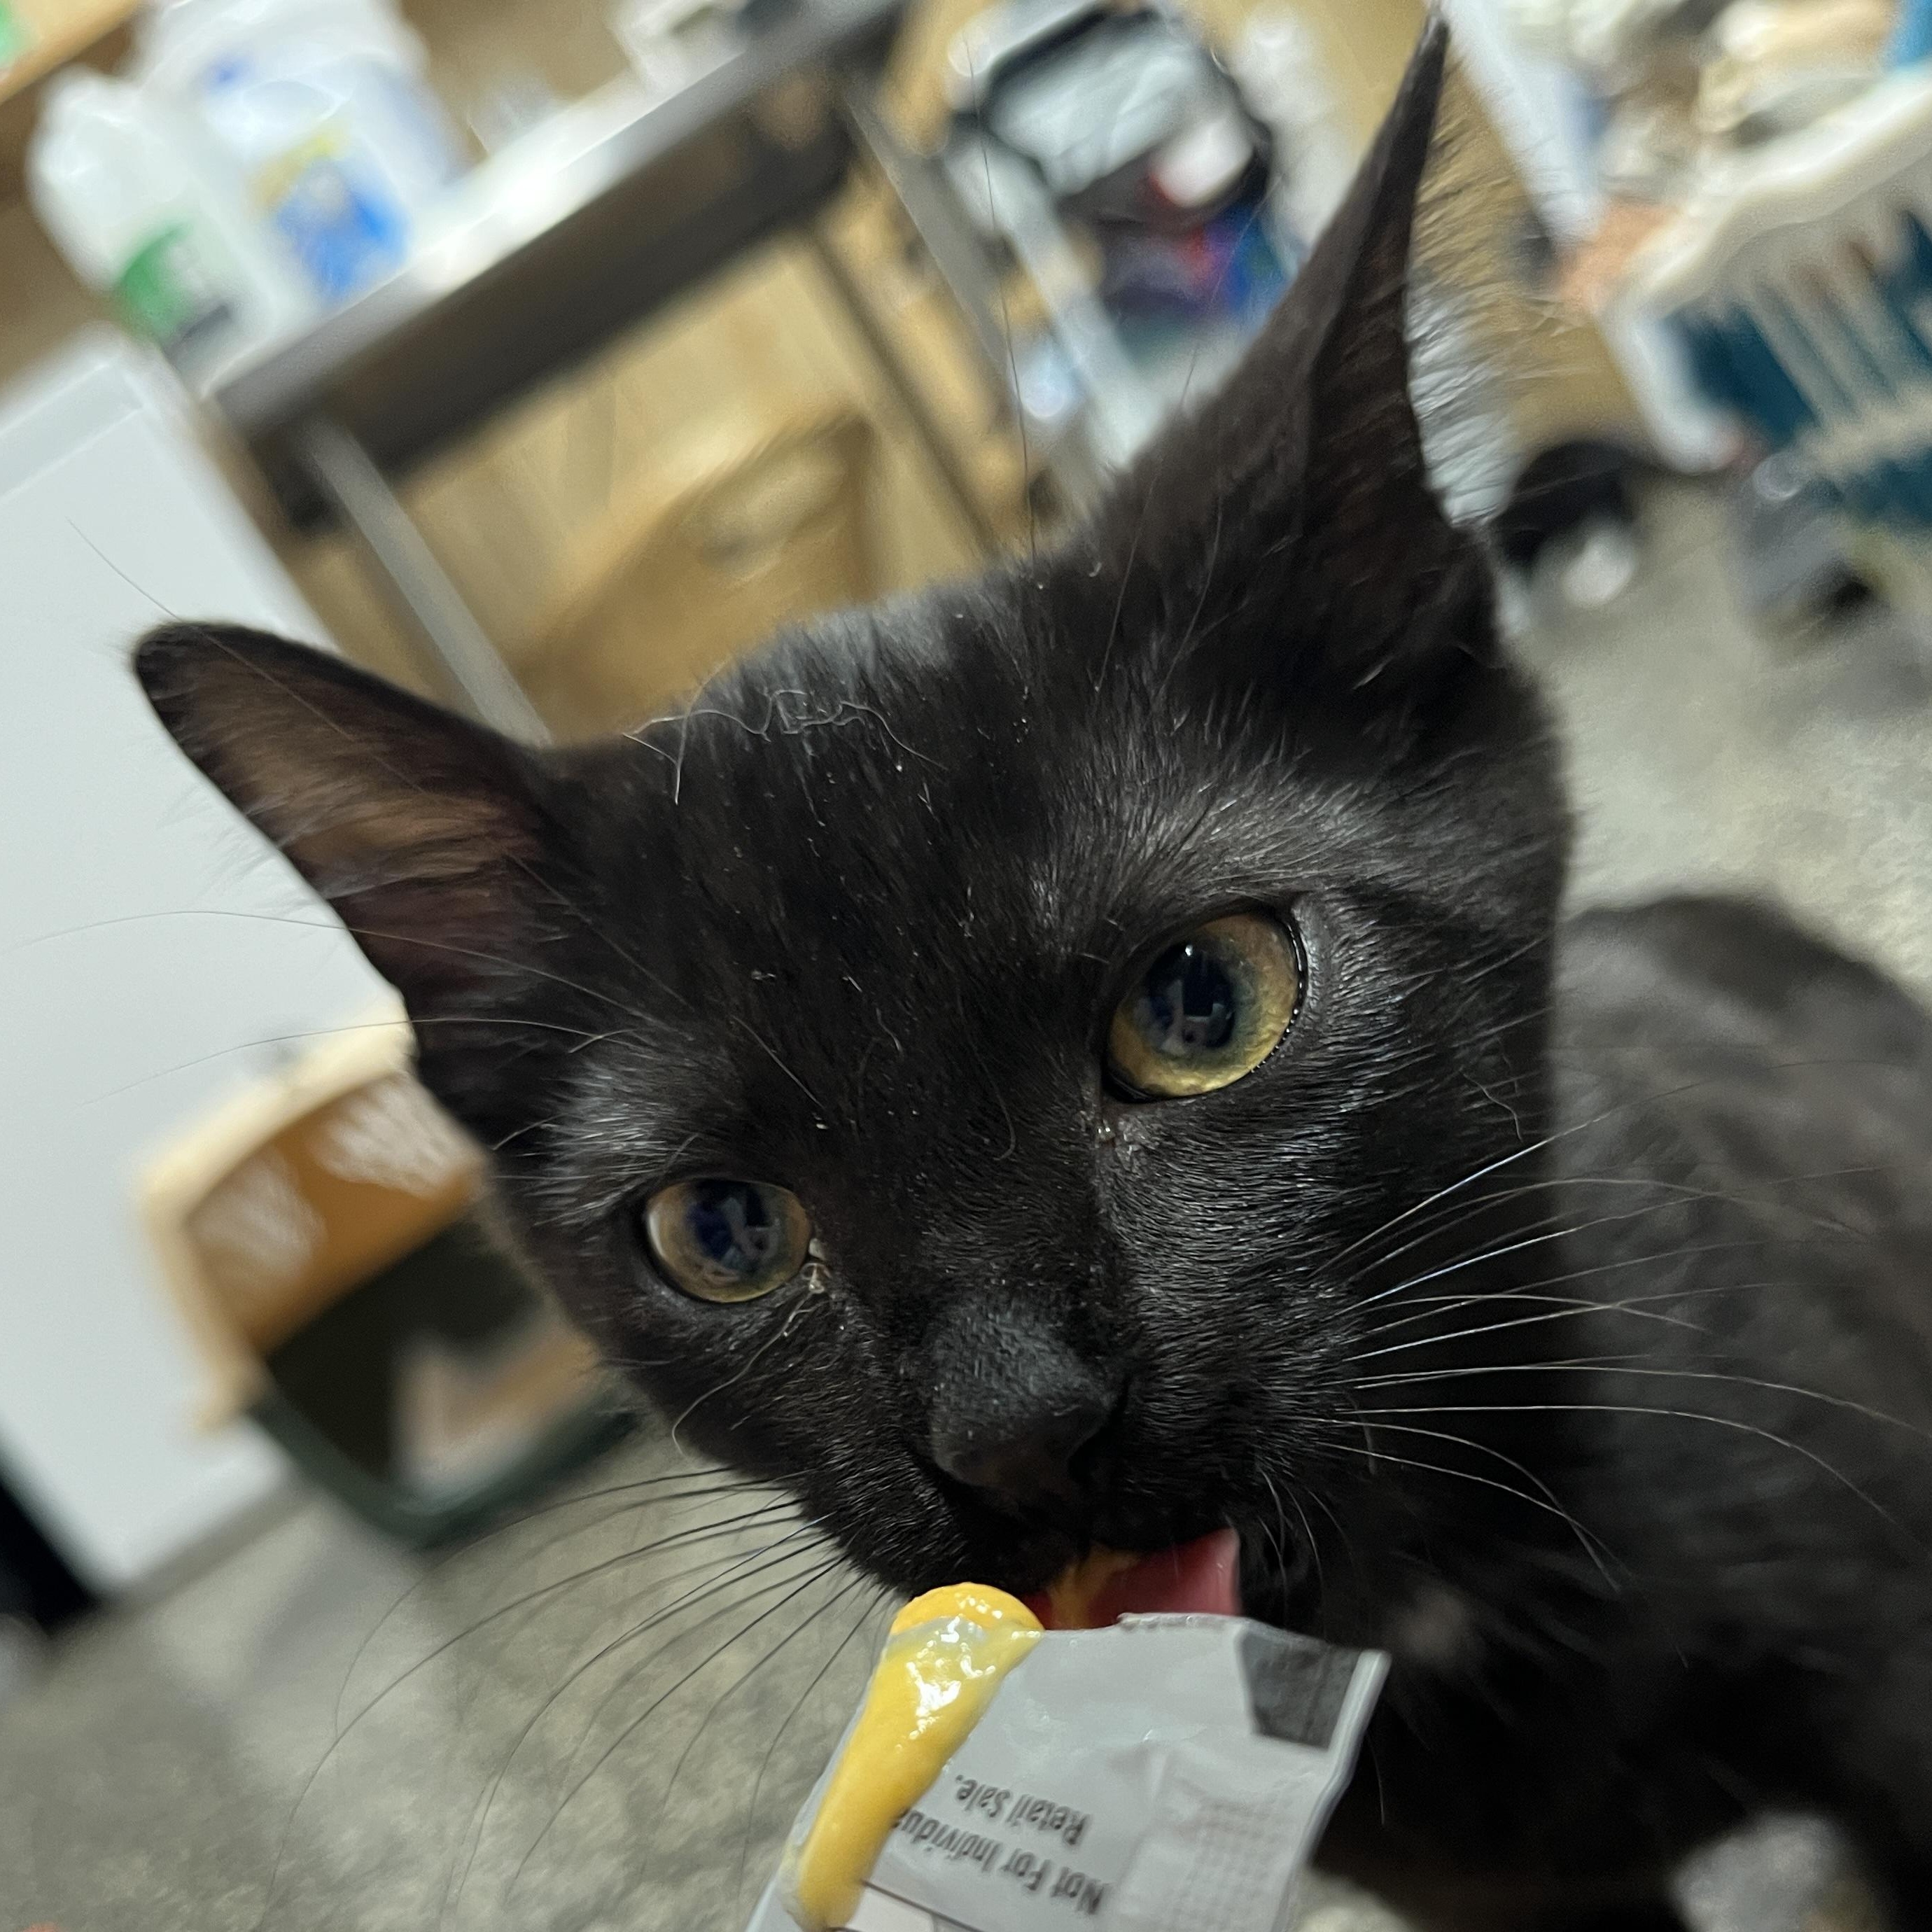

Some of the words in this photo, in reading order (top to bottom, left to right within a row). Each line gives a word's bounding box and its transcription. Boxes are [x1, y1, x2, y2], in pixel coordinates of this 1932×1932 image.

[955, 1774, 1011, 1818] Sale.
[1006, 1793, 1091, 1846] Retail
[1001, 1848, 1051, 1891] For
[1051, 1867, 1110, 1915] Not
